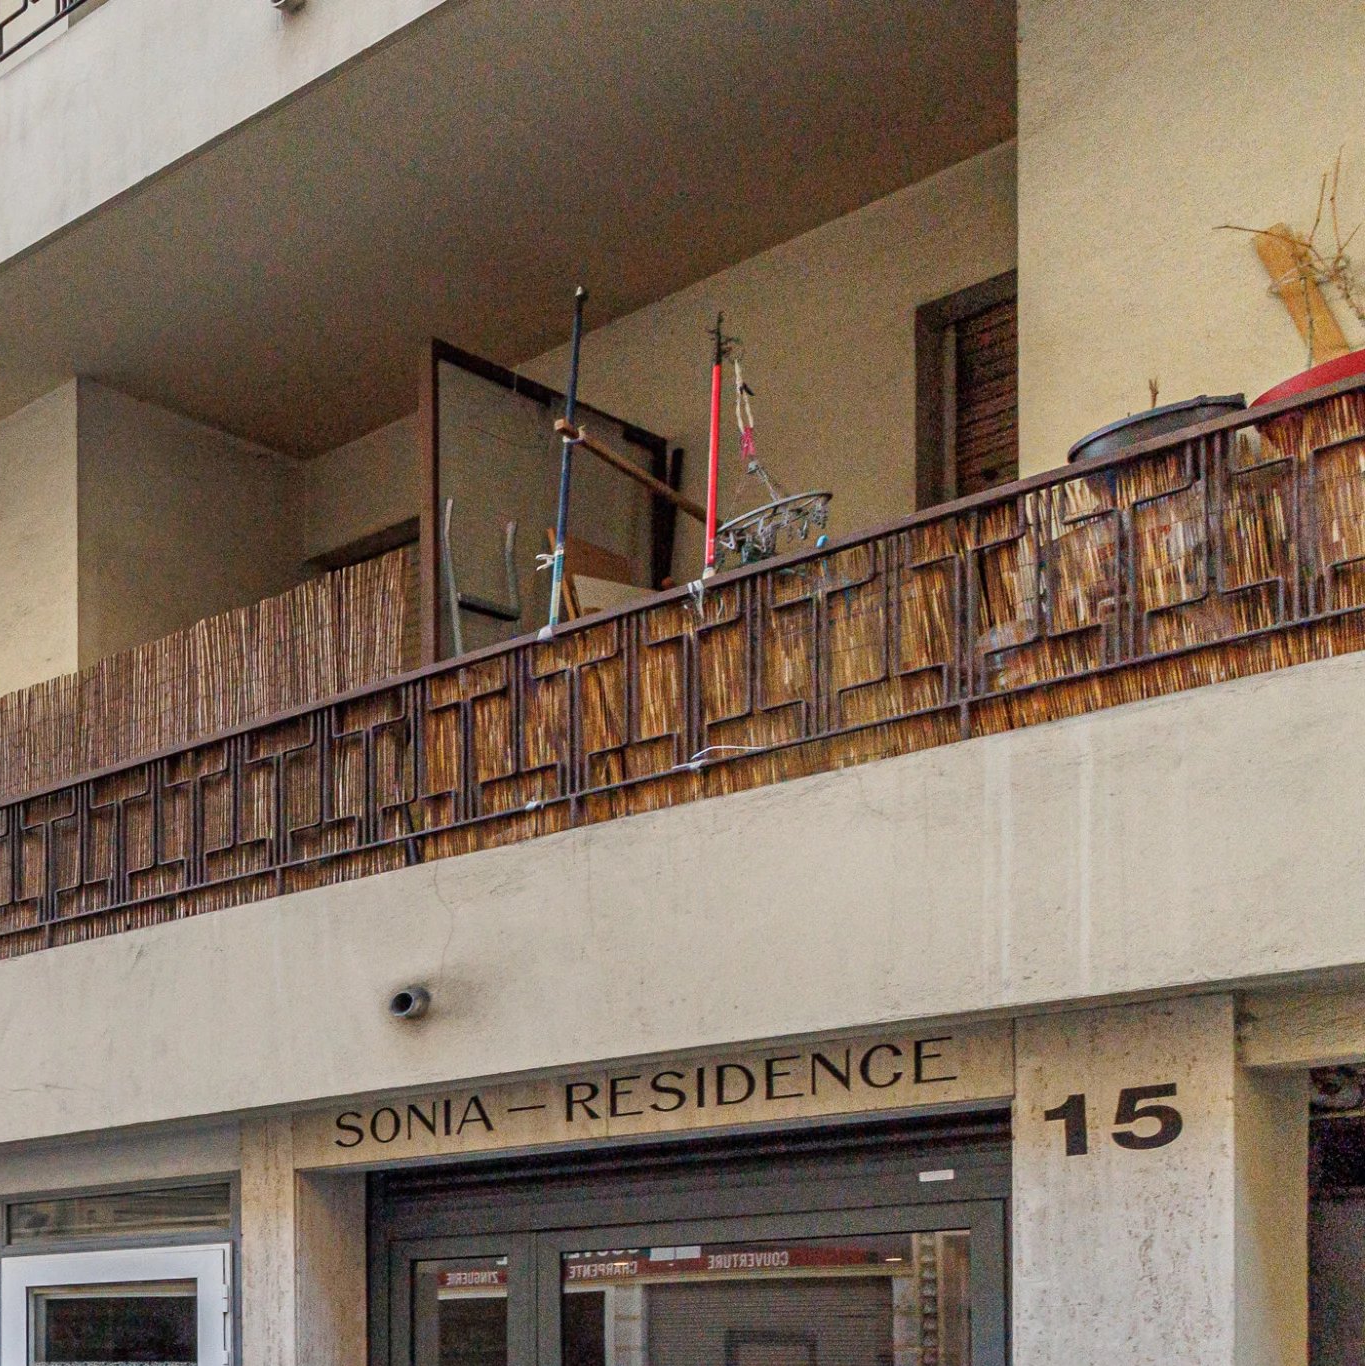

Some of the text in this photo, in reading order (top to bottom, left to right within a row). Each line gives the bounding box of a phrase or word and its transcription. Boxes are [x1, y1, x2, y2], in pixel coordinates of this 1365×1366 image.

[333, 1094, 495, 1149] SONIA
[563, 1034, 959, 1124] RESIDENCE
[1043, 1081, 1184, 1157] 15
